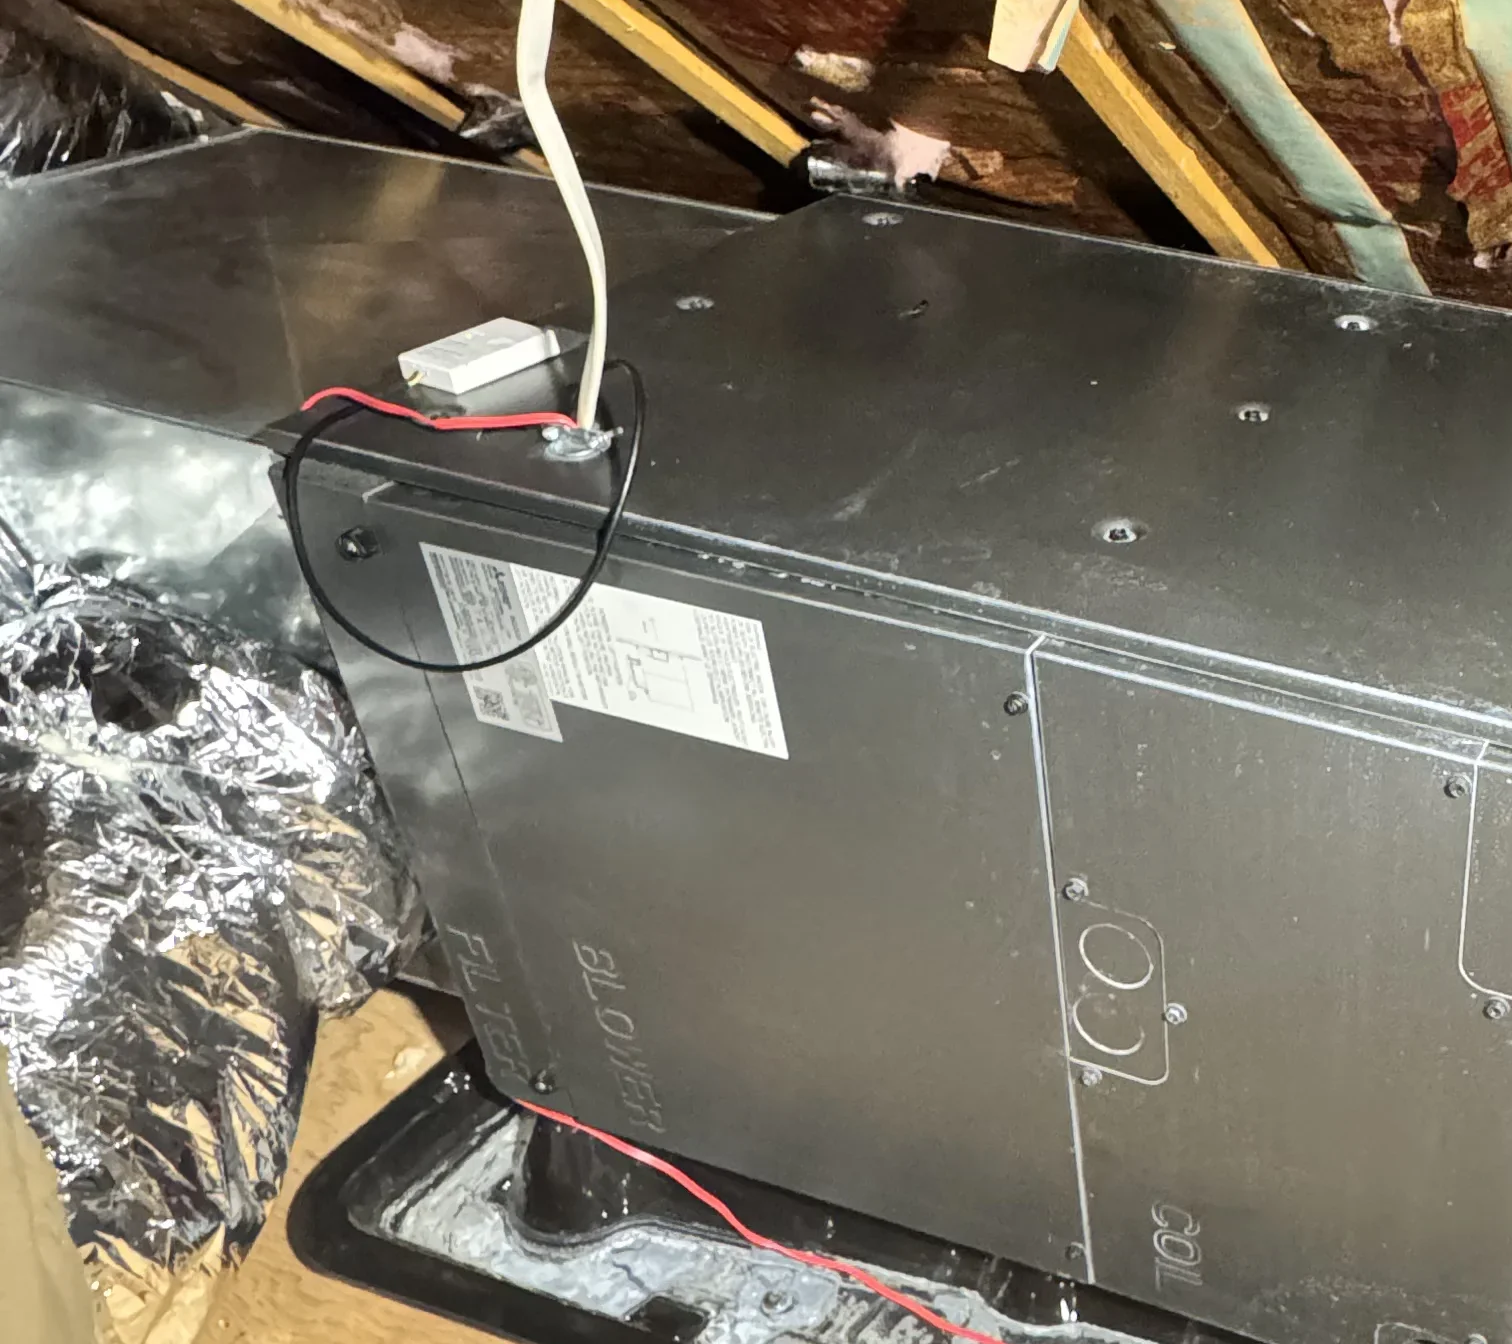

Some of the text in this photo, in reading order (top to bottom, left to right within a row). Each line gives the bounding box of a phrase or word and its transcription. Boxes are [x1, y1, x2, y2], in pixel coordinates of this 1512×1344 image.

[445, 923, 533, 1085] FILTER
[571, 939, 667, 1136] BLOWER
[1150, 1199, 1204, 1294] COIL
